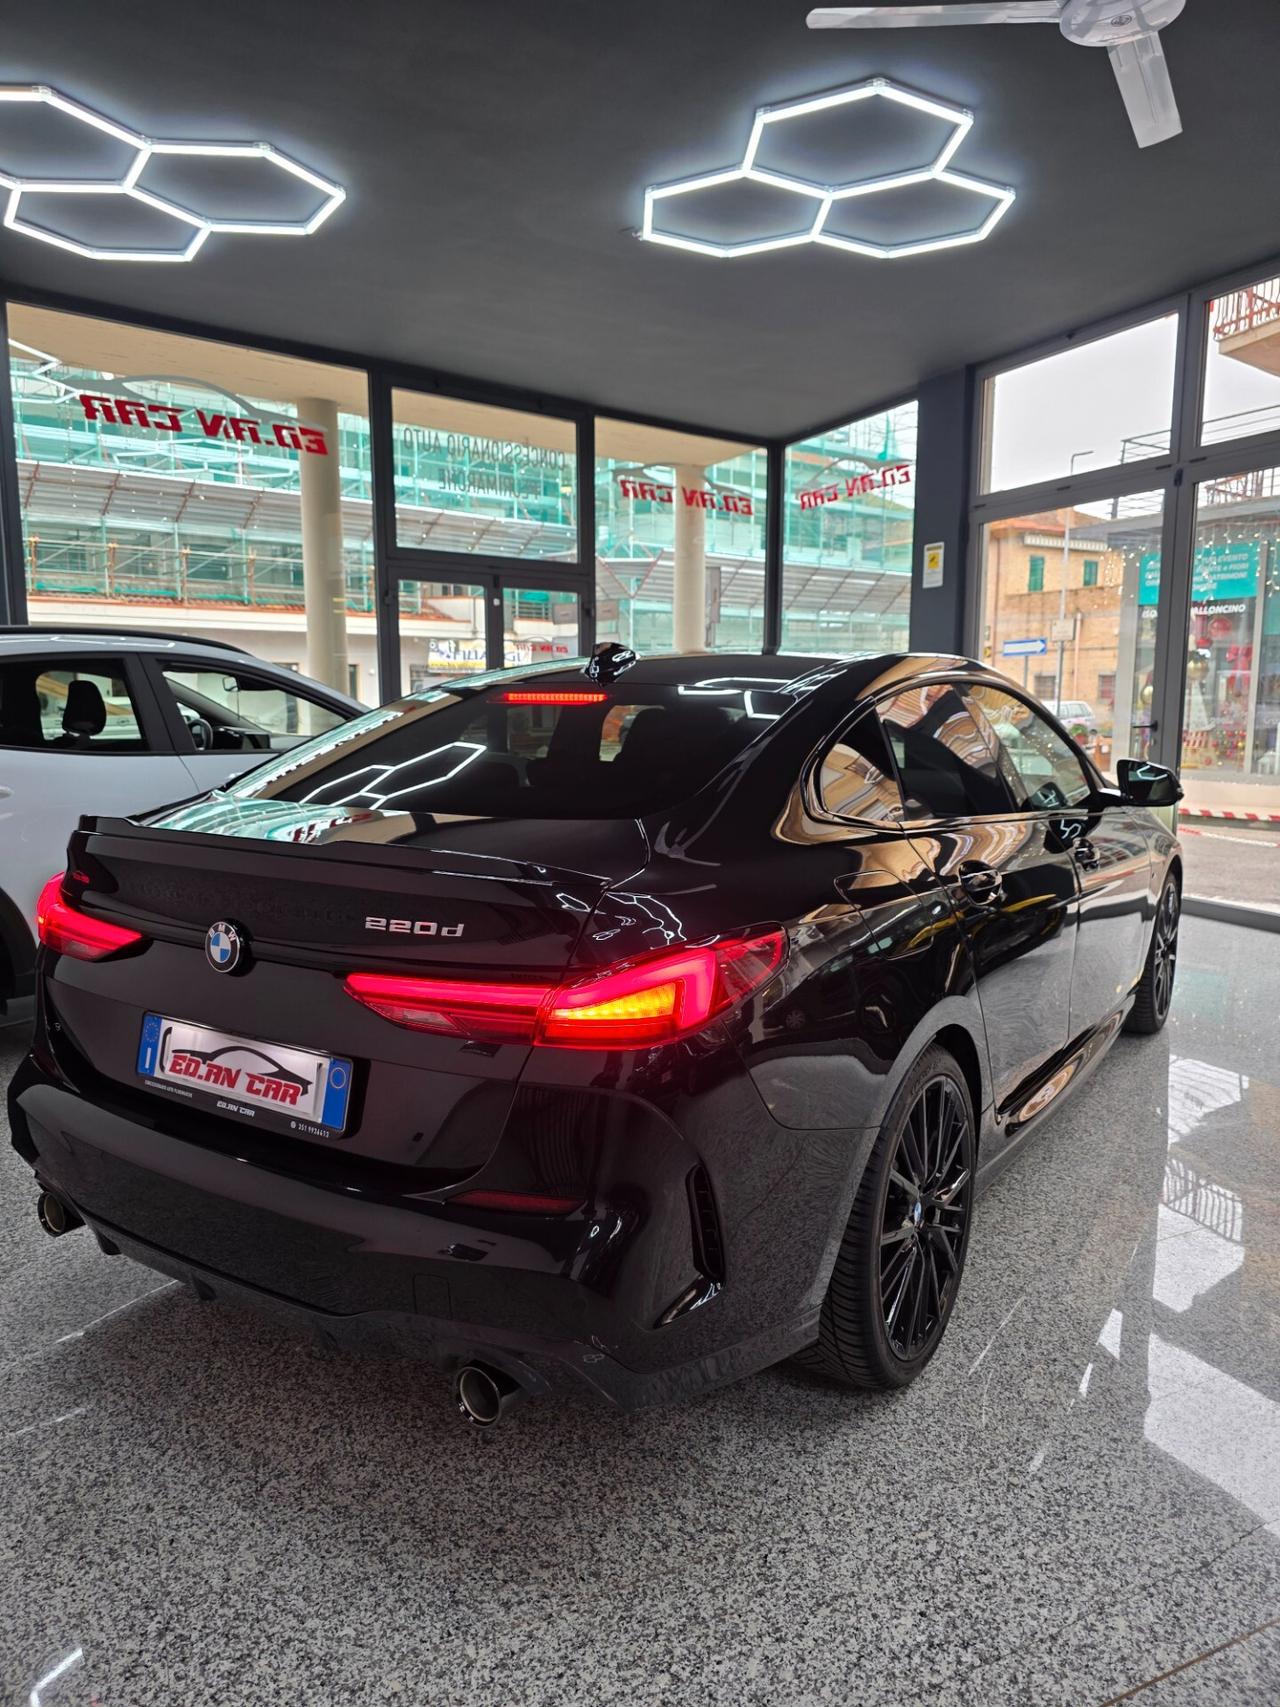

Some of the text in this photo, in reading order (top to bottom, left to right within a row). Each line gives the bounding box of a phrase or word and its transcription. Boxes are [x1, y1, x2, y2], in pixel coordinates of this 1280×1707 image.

[208, 923, 237, 942] BMW
[365, 916, 465, 937] 220d
[169, 1052, 241, 1089] ED.AN
[246, 1073, 303, 1106] CAR
[239, 1106, 256, 1118] CAR
